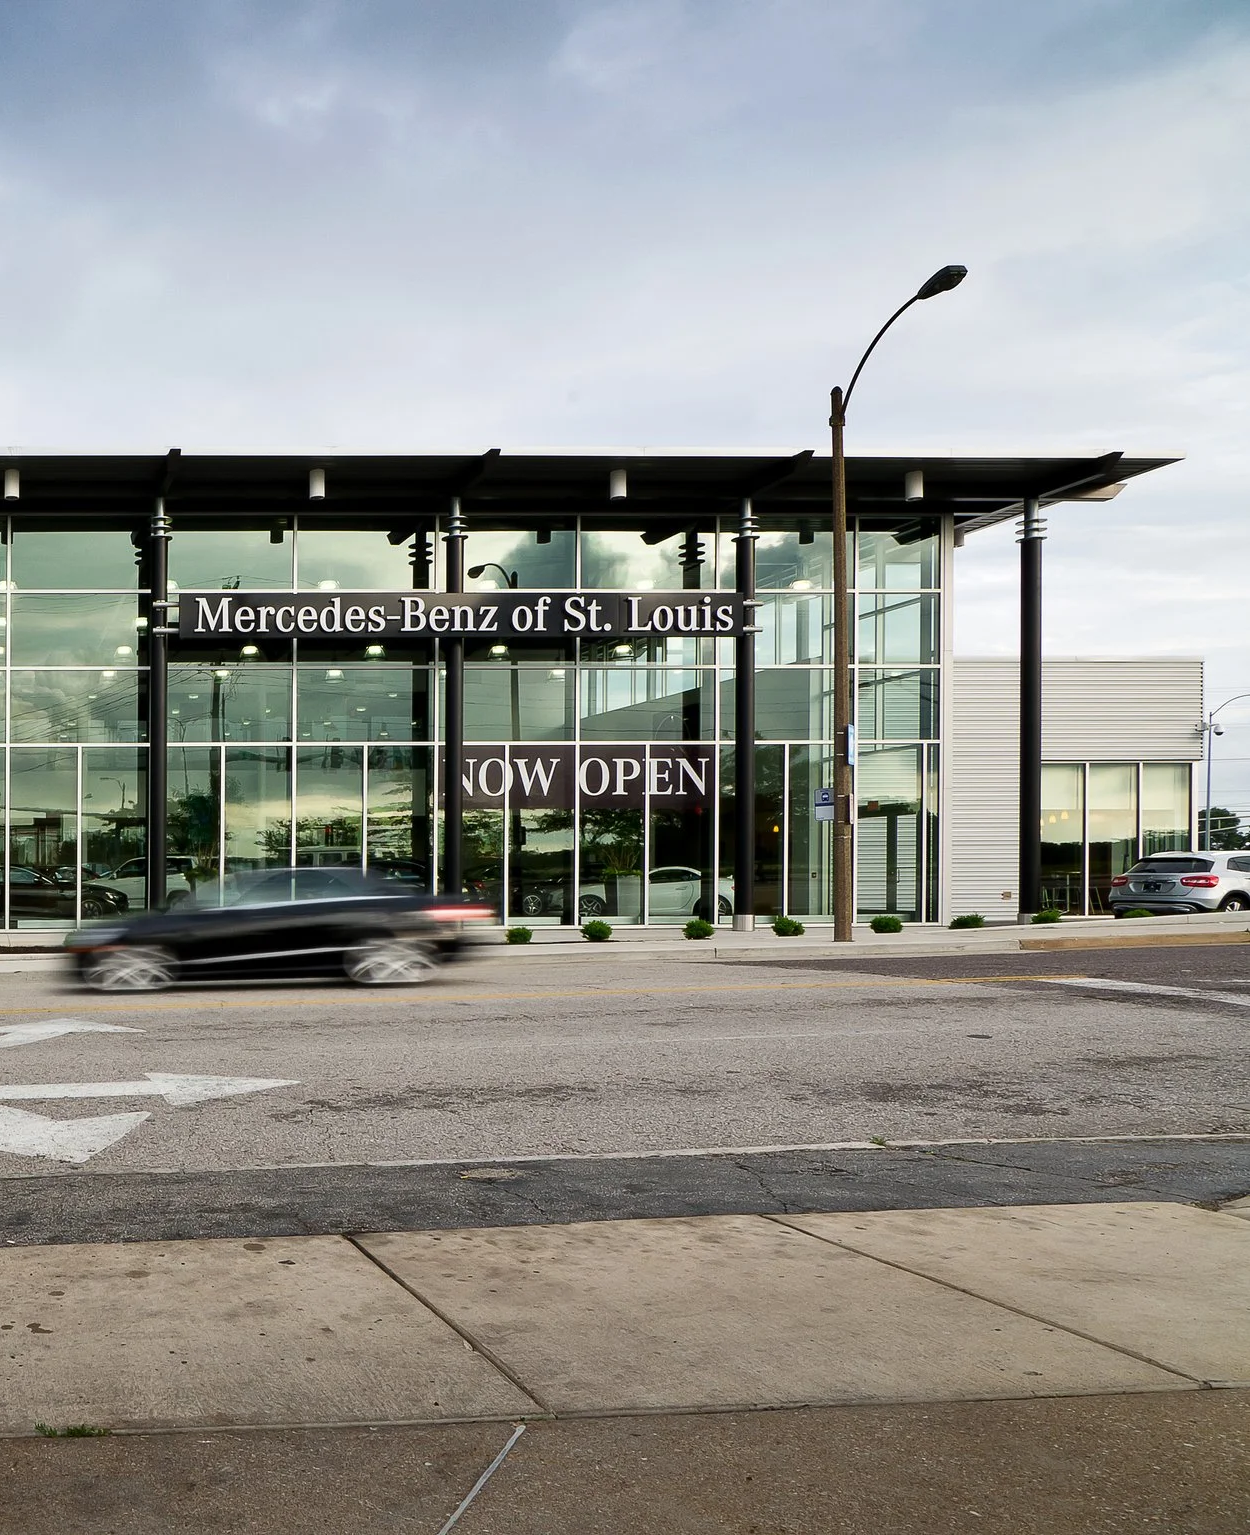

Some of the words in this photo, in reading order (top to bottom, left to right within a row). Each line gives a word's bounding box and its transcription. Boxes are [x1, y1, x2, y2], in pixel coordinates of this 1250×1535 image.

[194, 597, 498, 633] Mercedes-Benz
[512, 596, 552, 632] of
[564, 596, 612, 632] St.
[627, 596, 734, 632] Louis
[579, 757, 709, 796] OPEN
